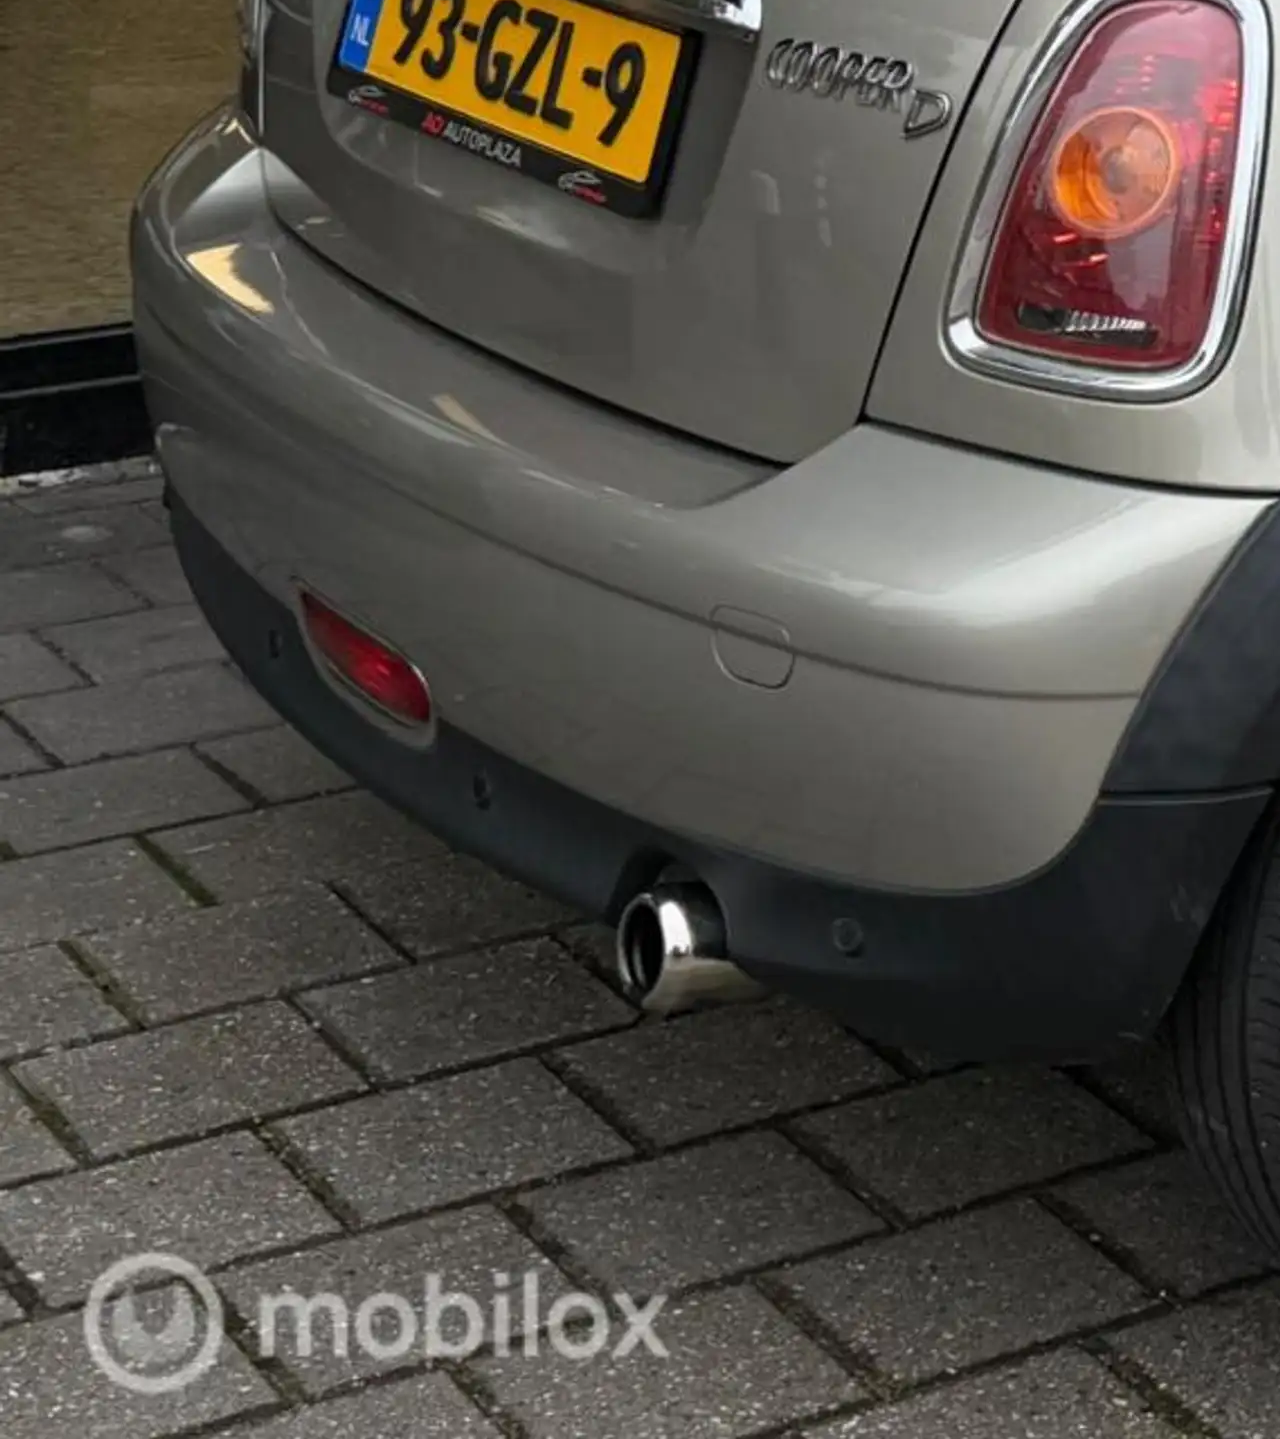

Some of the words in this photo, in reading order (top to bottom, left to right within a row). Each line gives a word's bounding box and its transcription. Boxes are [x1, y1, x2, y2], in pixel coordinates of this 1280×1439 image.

[349, 13, 370, 48] NL
[903, 88, 954, 140] D
[444, 119, 522, 168] AUTOPLAZA
